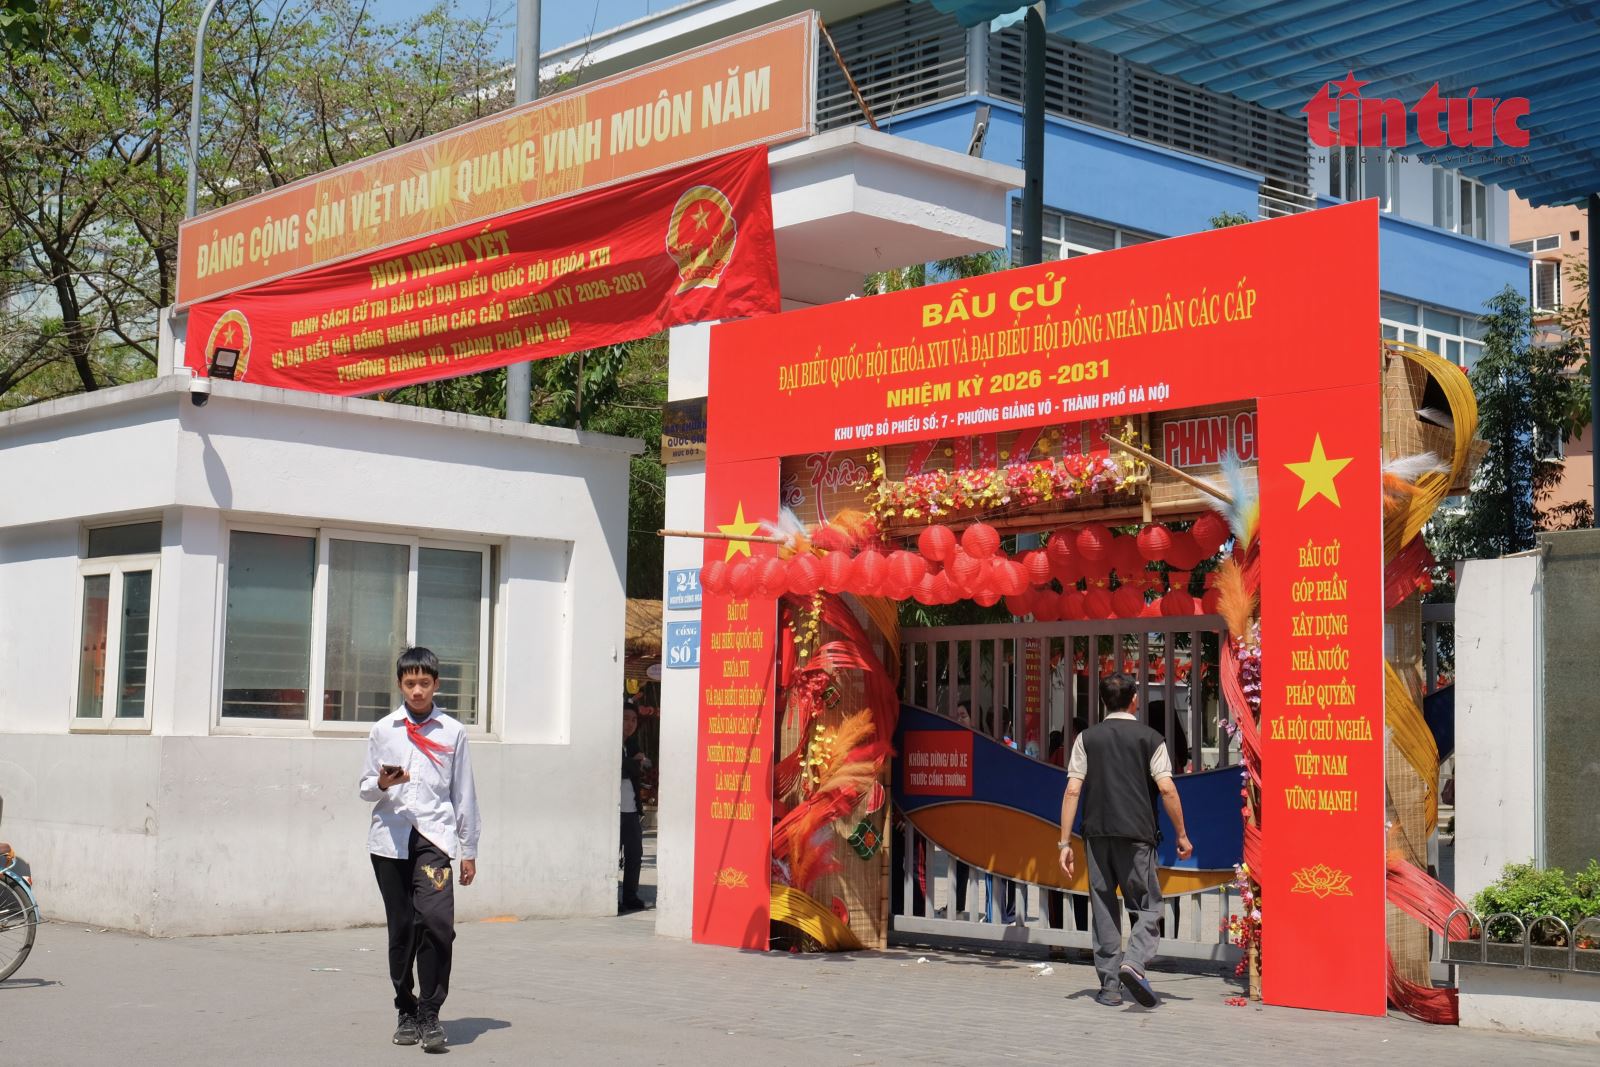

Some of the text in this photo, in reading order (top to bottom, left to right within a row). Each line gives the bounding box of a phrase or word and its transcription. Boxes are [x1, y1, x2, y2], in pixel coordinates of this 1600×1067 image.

[196, 65, 771, 279] ĐẢNG CỘNG SẢN VIỆT NAM QUANG VINH MUÔN NĂM
[407, 242, 467, 280] NIÊM
[468, 223, 510, 263] YẾT
[291, 246, 611, 338] DANH SÁCH CỬ TRI BẦU CỬ ĐẠI BIỂU QUỐC HỘI KHÓA XVI
[922, 271, 1067, 328] BẦU CỬ
[272, 271, 647, 369] VÀ ĐẠI BIỂU HỘI ĐỒNG NHÂN DÂN CÁC CẤP NHIỆM KỲ 2026-2031
[337, 316, 571, 384] PHƯỜNG GIẢNG VÕ, THÀNH PHỐ HÀ NỘI
[779, 276, 1257, 396] ĐẠI BIỂU QUỐC HỘI KHÓA XVI VÀ ĐẠI BIỂU HỘI ĐỒNG NHÂN DÂN CÁC CẤP
[887, 382, 951, 409] NHIỆM
[957, 374, 984, 398] KỲ
[990, 370, 1042, 394] 2026
[834, 428, 853, 441] KHU
[855, 423, 873, 440] VỰC
[876, 418, 889, 435] BỎ
[891, 415, 920, 434] PHIẾU
[922, 411, 939, 430] SỐ:
[942, 415, 948, 428] 7
[957, 407, 999, 426] PHƯỜNG
[1002, 400, 1035, 419] GIẢNG
[1037, 400, 1052, 415] VÕ
[1062, 393, 1099, 412] THÀNH
[1102, 385, 1126, 407] PHỐ
[1129, 385, 1145, 404] HÀ
[1148, 382, 1170, 403] NỘI
[1163, 415, 1228, 468] PHAN
[1234, 411, 1258, 463] C
[1299, 538, 1341, 567] BẦU CỬ
[676, 571, 698, 592] 24
[1292, 572, 1347, 602] GÓP PHẦN
[675, 624, 697, 637] CỔNG
[1292, 611, 1348, 640] XÂY DỰNG
[670, 638, 691, 664] SỐ
[1292, 644, 1349, 671] NHÀ NƯỚC
[739, 660, 750, 677] XVI
[1286, 676, 1356, 710] PHÁP QUYỀN
[1271, 713, 1373, 744] XÃ HỘI CHỦ NGHĨA
[908, 750, 929, 767] KHÔNG
[959, 753, 967, 768] XE
[1294, 749, 1348, 780] VIỆT NAM
[1285, 785, 1316, 810] VỮNG
[1318, 790, 1352, 815] MẠNH
